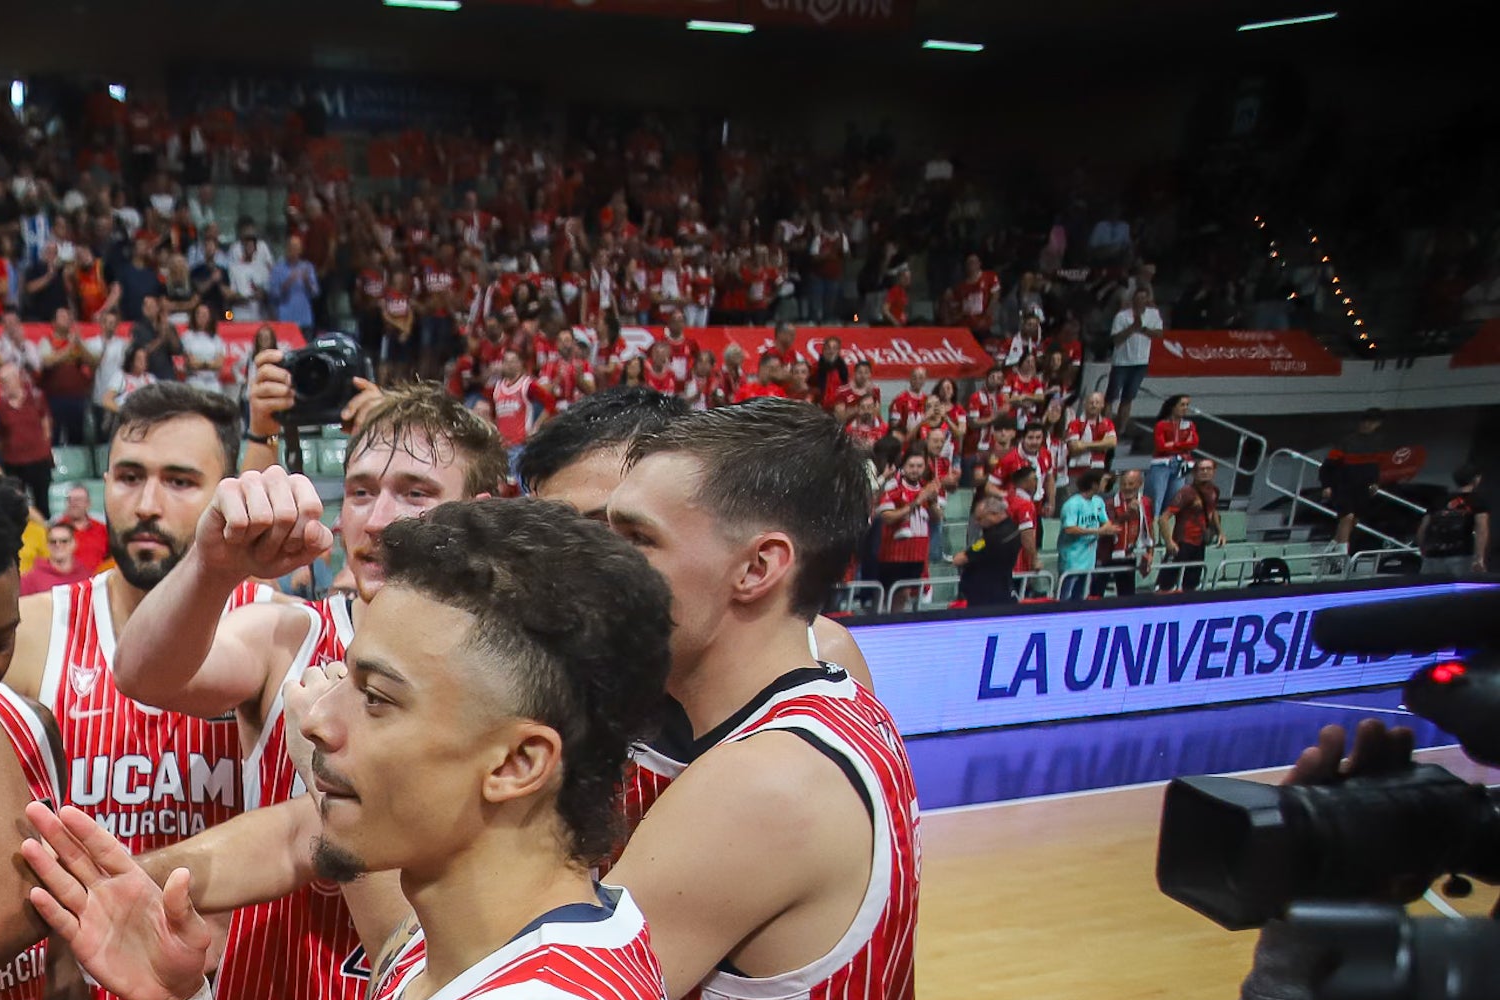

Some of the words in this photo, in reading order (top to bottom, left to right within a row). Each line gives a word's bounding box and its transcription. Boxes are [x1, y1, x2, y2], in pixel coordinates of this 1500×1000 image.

[977, 631, 1049, 700] LA
[1063, 609, 1394, 693] UNIVERSI
[70, 751, 235, 807] UCAM
[95, 809, 206, 838] MURCIA
